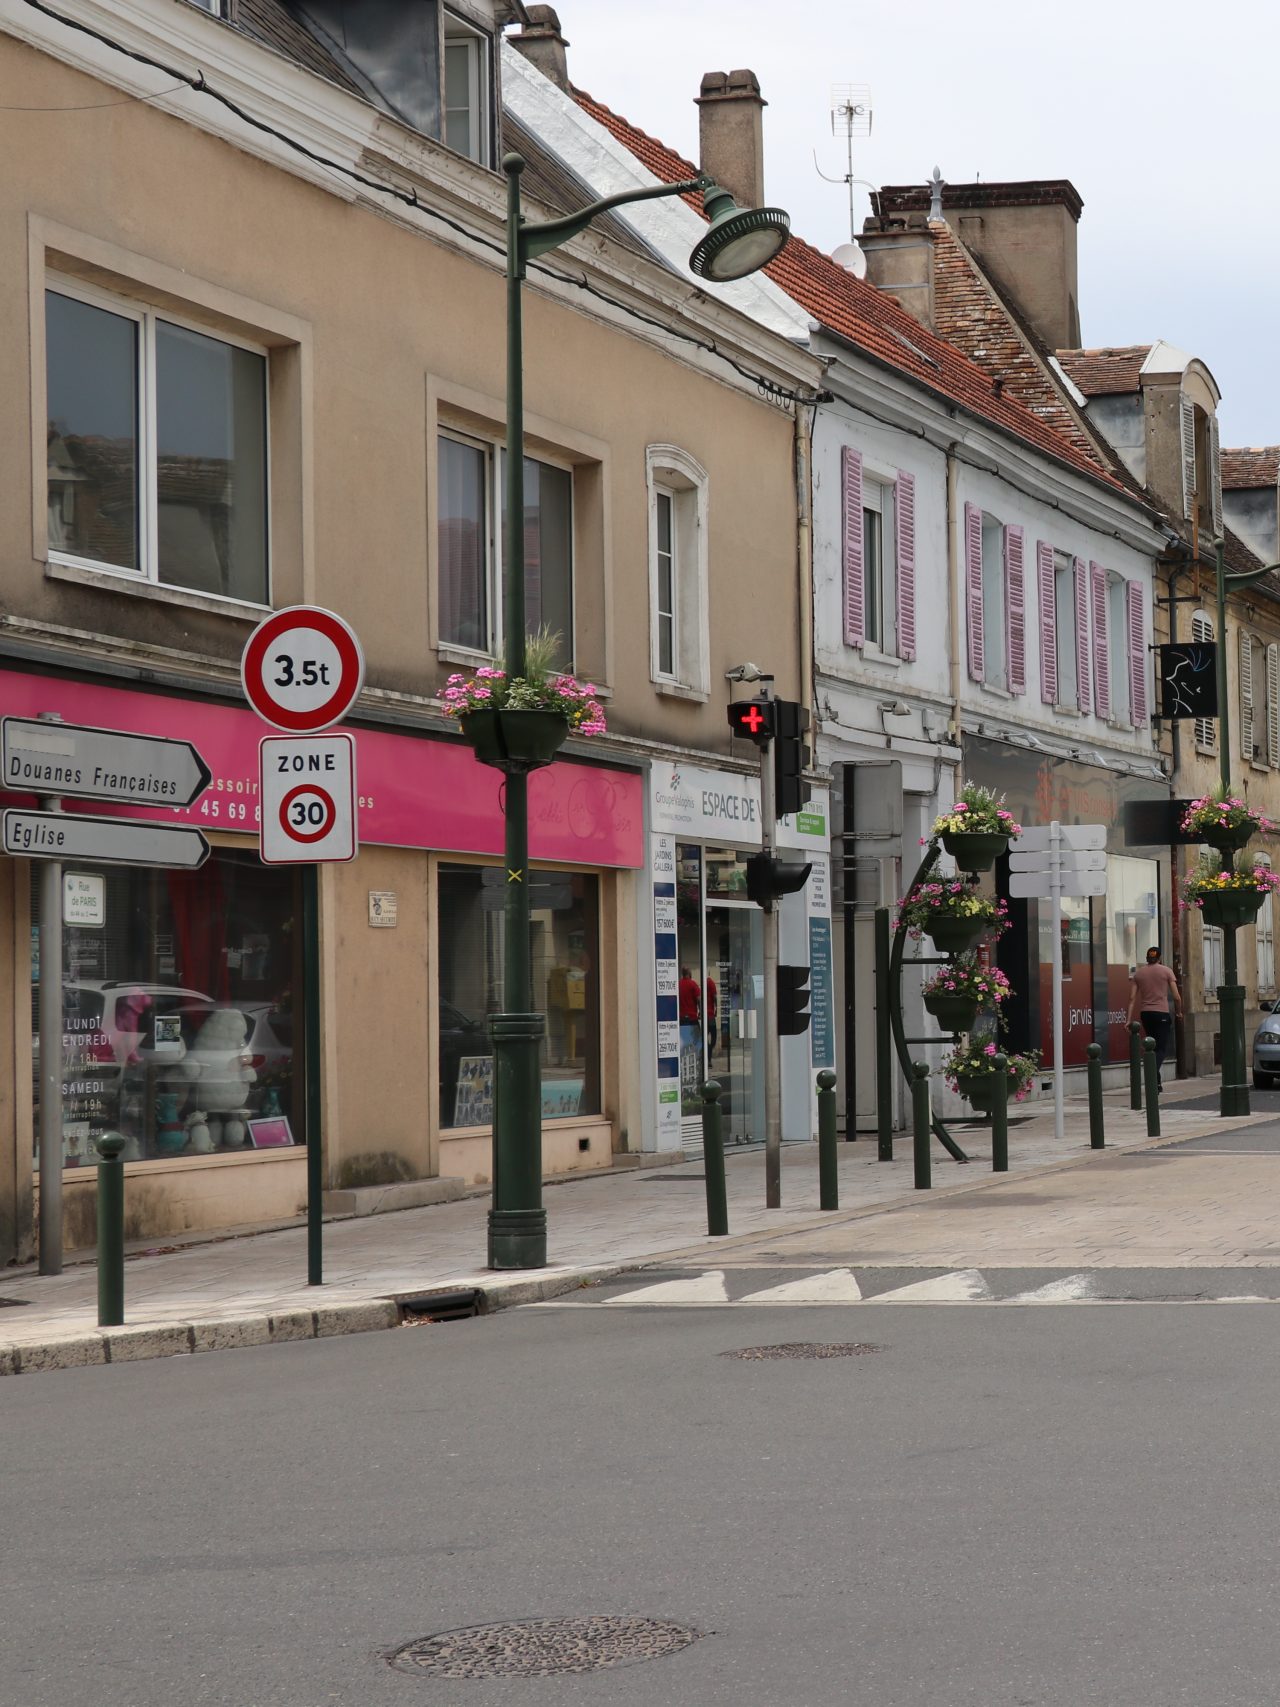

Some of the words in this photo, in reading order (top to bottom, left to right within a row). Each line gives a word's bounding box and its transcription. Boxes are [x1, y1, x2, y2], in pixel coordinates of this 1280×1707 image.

[274, 654, 331, 687] 3.5t
[278, 754, 335, 772] ZONE
[10, 756, 82, 784] Douanes
[93, 766, 177, 795] Françaises
[201, 799, 219, 817] 45
[228, 803, 246, 820] 69
[291, 801, 324, 825] 30
[702, 791, 739, 820] ESPACE
[741, 797, 755, 822] DE
[13, 822, 65, 848] Eglise
[655, 850, 672, 860] JARDINS
[79, 881, 90, 892] Rue
[80, 896, 97, 907] PARIS
[67, 1018, 101, 1029] LUNDI
[1068, 1005, 1093, 1032] jarvis
[62, 1034, 112, 1046] ENDREDI
[62, 1081, 104, 1094] SAMEDI
[84, 1098, 102, 1110] 19h
